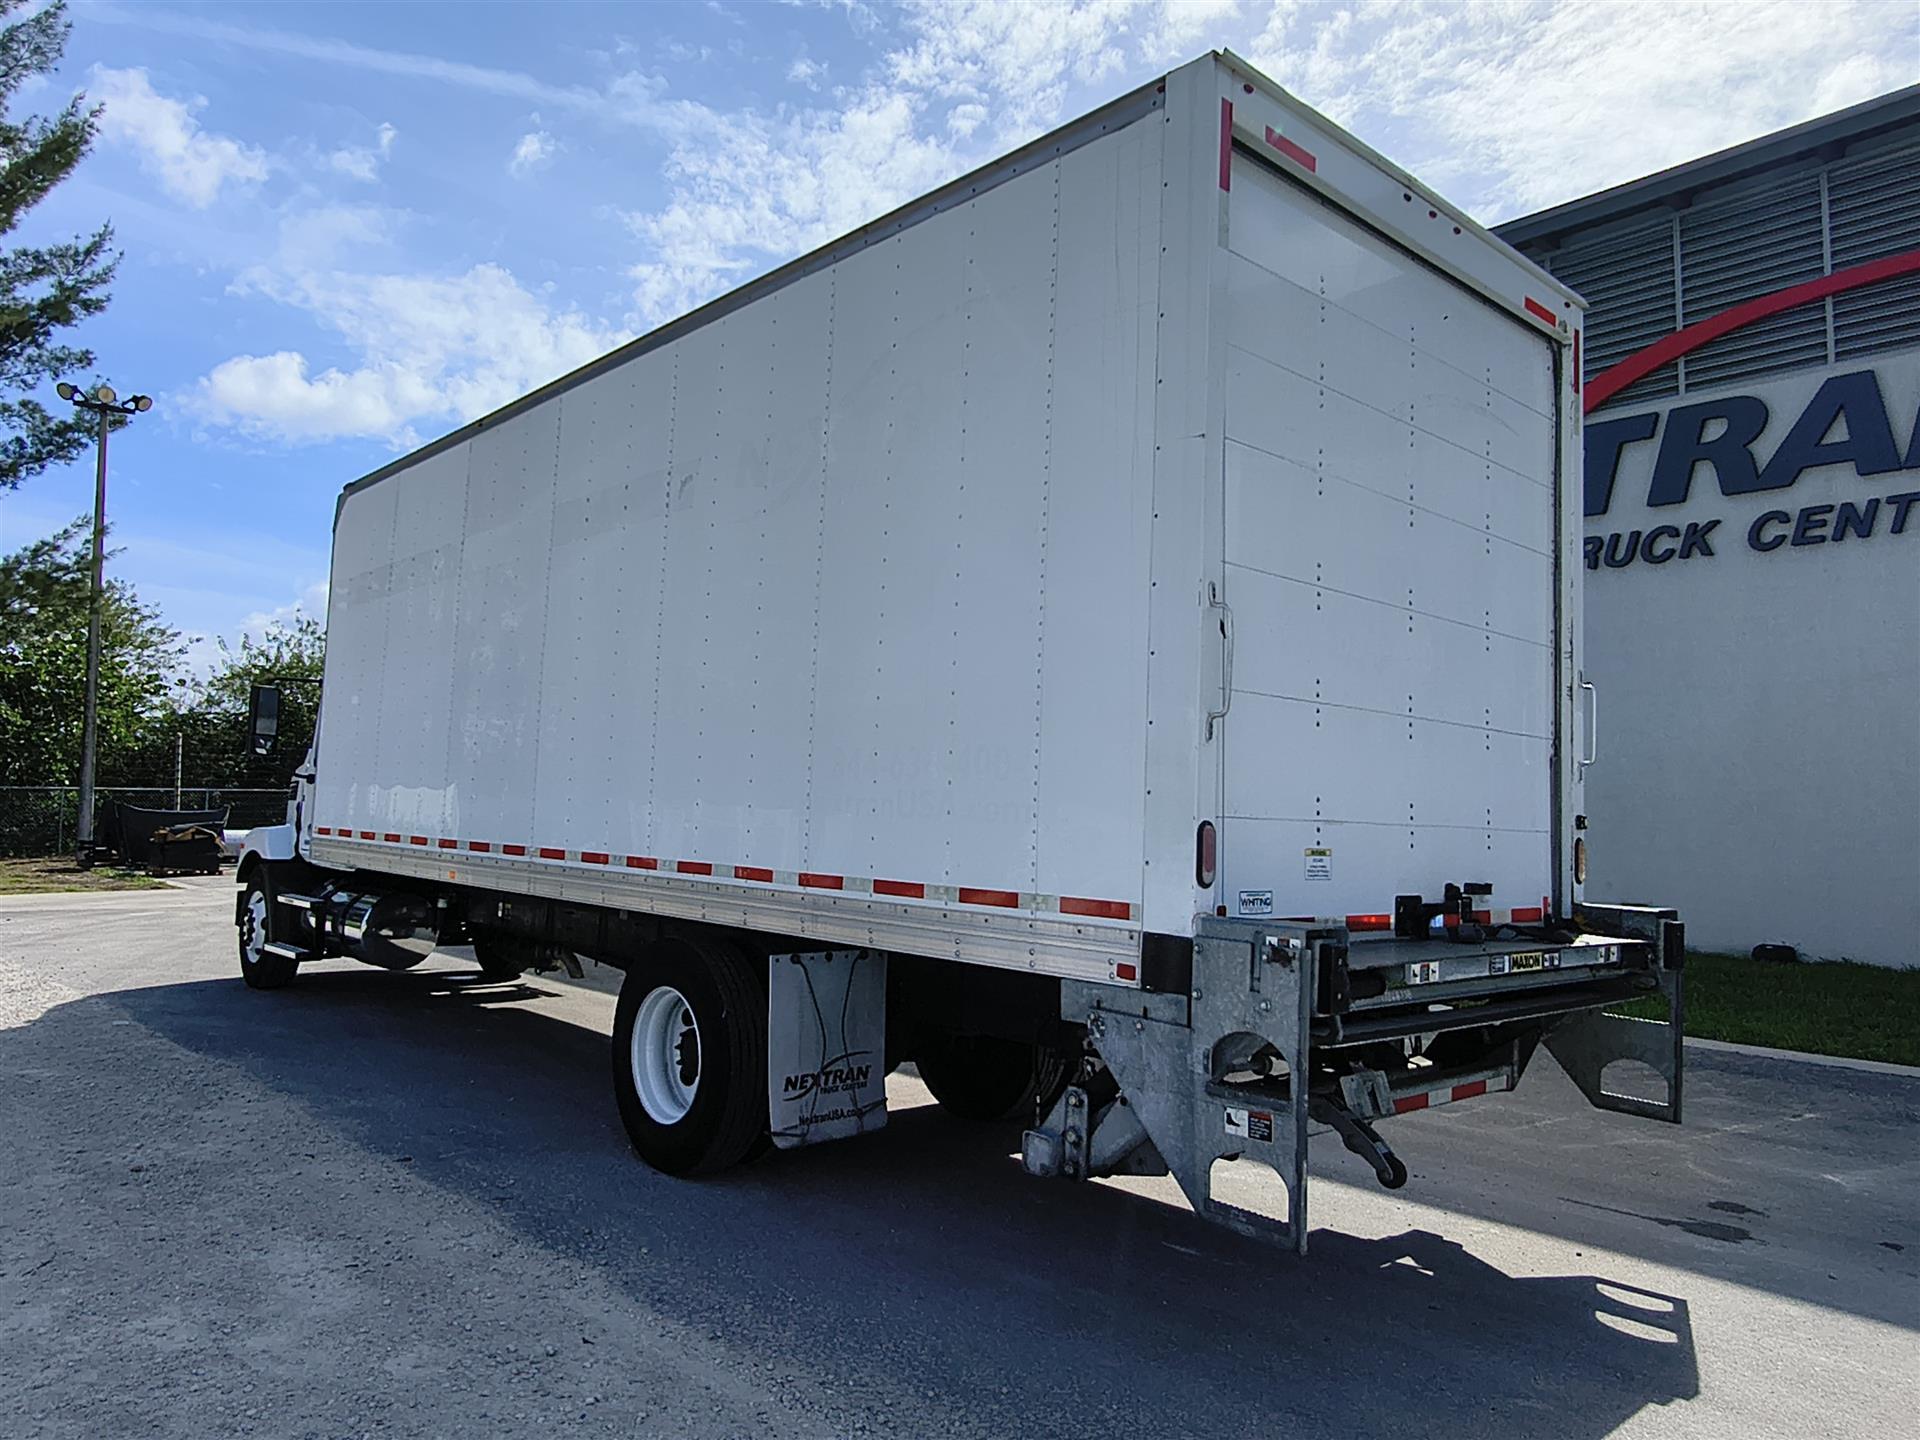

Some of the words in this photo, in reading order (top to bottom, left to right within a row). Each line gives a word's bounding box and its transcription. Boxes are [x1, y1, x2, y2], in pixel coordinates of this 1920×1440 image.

[1584, 369, 1920, 516] TRA
[1510, 953, 1541, 971] MAXON
[784, 1066, 869, 1092] NEXTRAN
